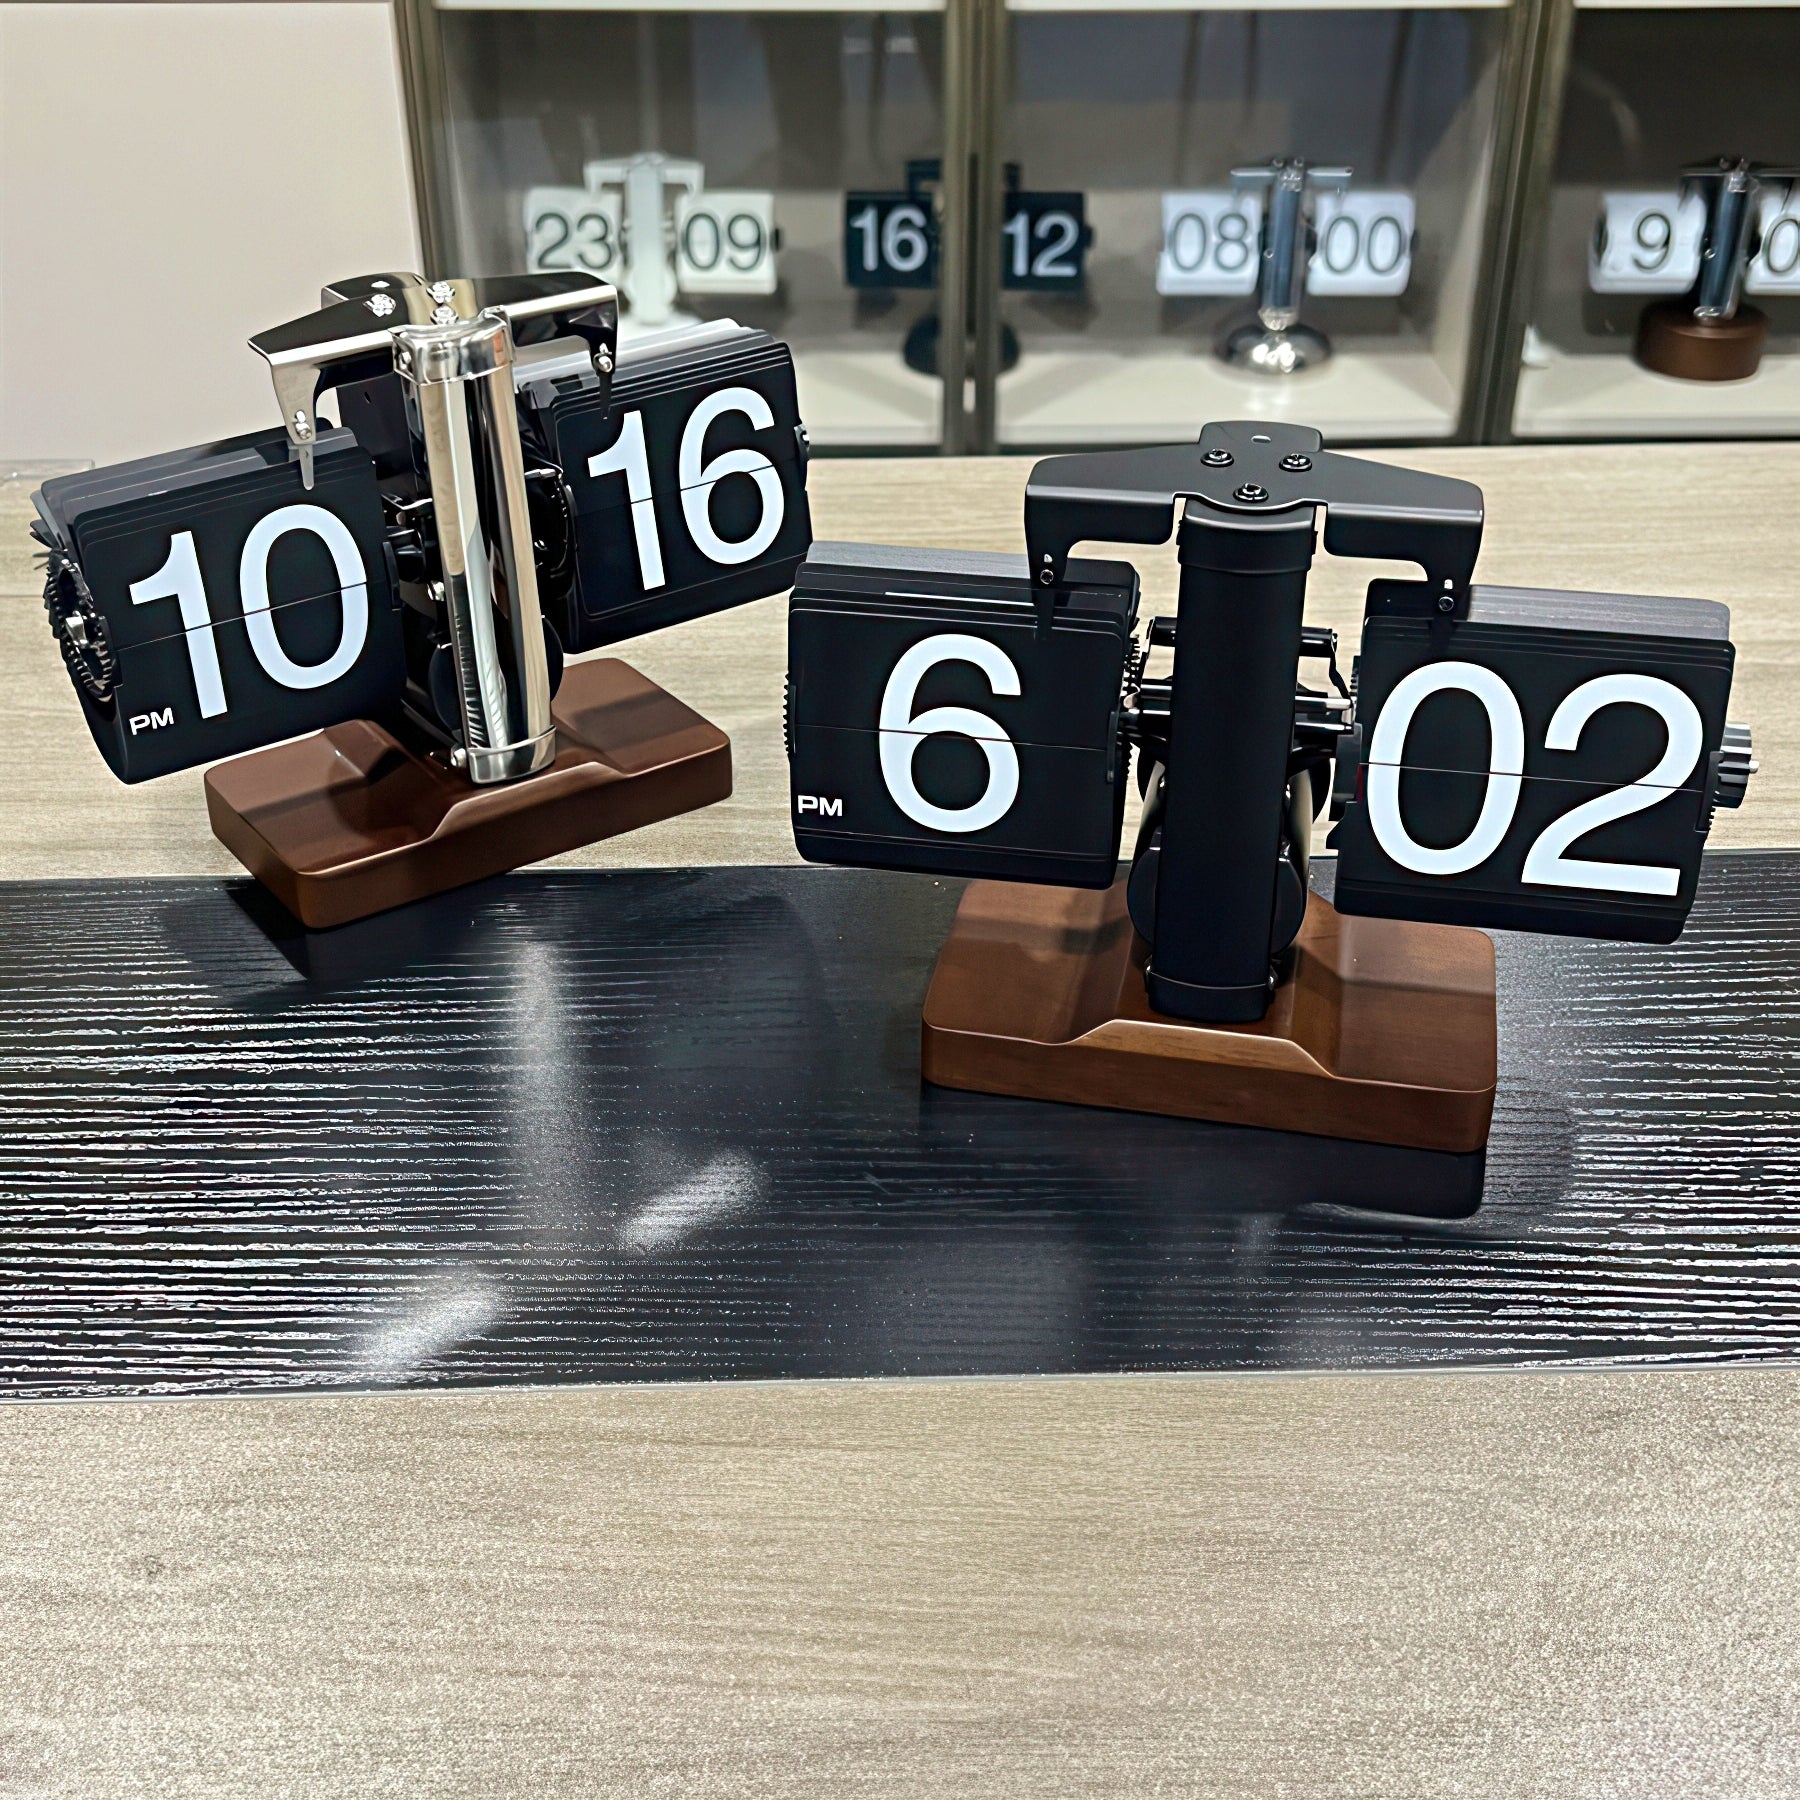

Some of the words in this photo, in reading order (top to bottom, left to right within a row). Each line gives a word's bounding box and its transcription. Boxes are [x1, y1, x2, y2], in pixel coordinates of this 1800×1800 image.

[533, 211, 614, 270] 23
[684, 212, 764, 272] 09
[850, 206, 929, 272] 16
[1002, 209, 1079, 277] 12
[1170, 212, 1250, 271] 08
[1325, 215, 1403, 273] 00
[1633, 212, 1672, 270] 9
[128, 503, 369, 720] 10
[588, 386, 785, 592] 16
[129, 707, 174, 735] PM
[878, 633, 1022, 833] 6
[1366, 660, 1704, 896] 02
[797, 794, 843, 817] PM
